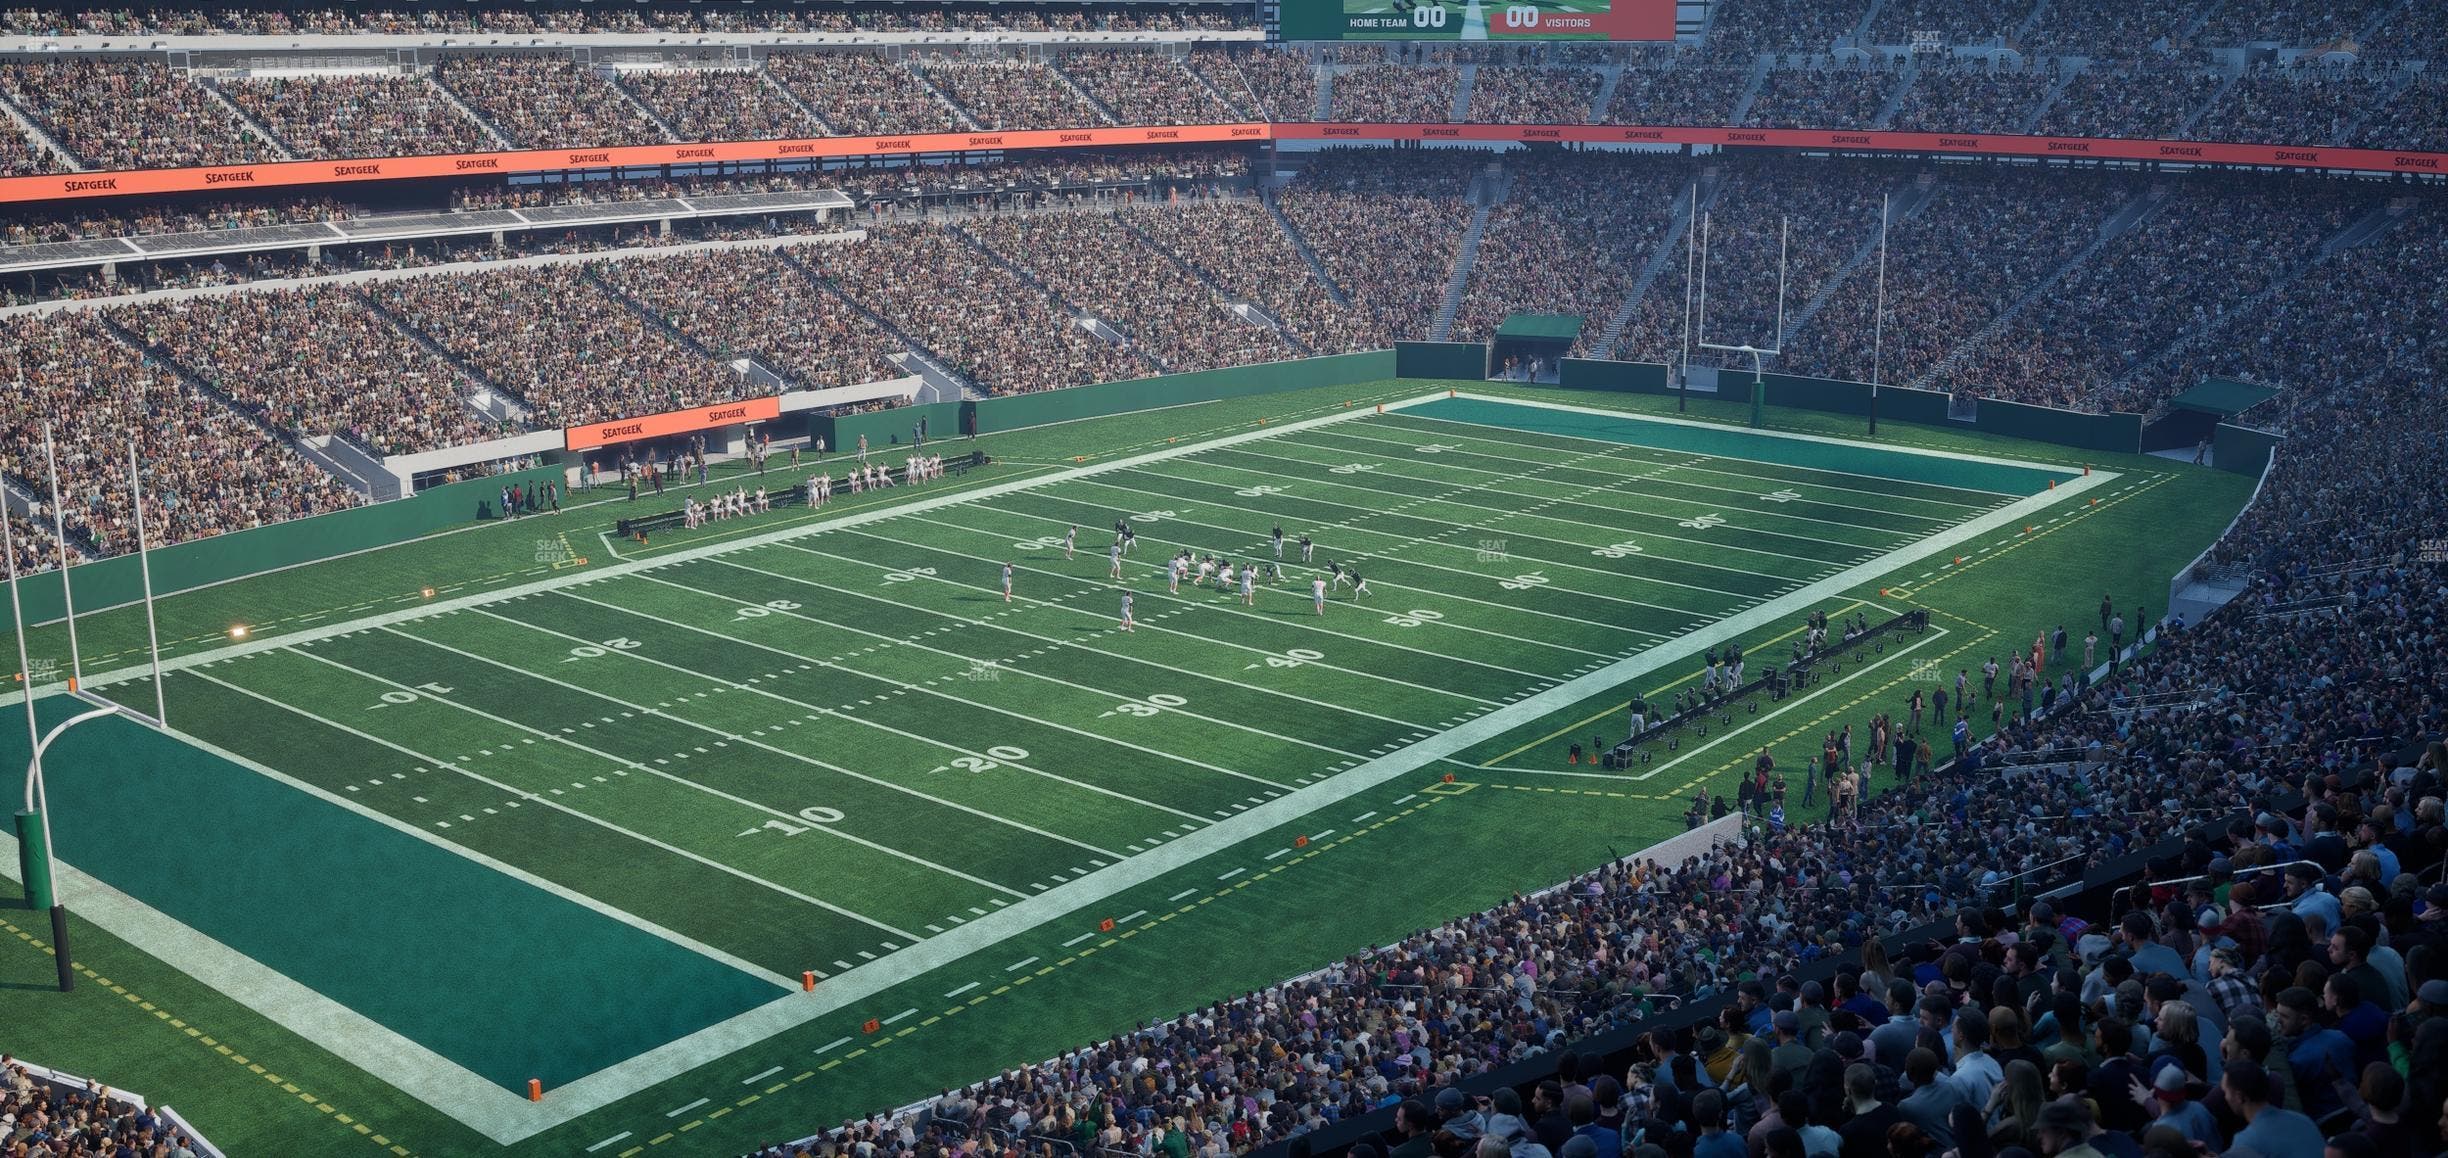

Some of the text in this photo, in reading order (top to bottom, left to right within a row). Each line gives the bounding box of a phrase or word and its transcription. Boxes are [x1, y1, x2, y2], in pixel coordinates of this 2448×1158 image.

[1349, 5, 1446, 28] HOME TEAM 00
[1506, 5, 1591, 28] 00 VISITORS
[1060, 132, 1092, 143] SEATGEEK
[1146, 130, 1178, 140] SEATGEEK
[1231, 128, 1261, 137] SEATGEEK
[1322, 127, 1360, 136] SEATGEEK
[1422, 128, 1460, 137] SEATGEEK
[1523, 129, 1561, 138] SEATGEEK
[1624, 130, 1663, 140] SEATGEEK
[1727, 132, 1766, 142] SEATGEEK
[875, 140, 911, 150] SEATGEEK
[968, 136, 1003, 146] SEATGEEK
[1831, 135, 1871, 145] SEATGEEK
[1939, 138, 1978, 148] SEATGEEK
[2047, 141, 2089, 152] SEATGEEK
[676, 148, 715, 159] SEATGEEK
[778, 144, 814, 154] SEATGEEK
[2159, 145, 2202, 157] SEATGEEK
[569, 152, 609, 164] SEATGEEK
[2274, 151, 2318, 162] SEATGEEK
[2394, 156, 2439, 169] SEATGEEK
[334, 164, 380, 177] SEATGEEK
[456, 158, 498, 170] SEATGEEK
[205, 170, 254, 184] SEATGEEK
[64, 178, 117, 193] SEATGEEK
[709, 406, 747, 422] SEATGEEK
[602, 422, 643, 440] SEATGEEK
[1677, 515, 1727, 530] 20
[1590, 543, 1643, 559] 30
[882, 566, 937, 583] 40
[1498, 573, 1550, 591] 40
[736, 599, 802, 618] 30
[1382, 609, 1444, 628] 50
[569, 636, 642, 658] 20
[1265, 648, 1325, 669] 40
[380, 681, 455, 704] 10
[1115, 693, 1188, 718] 30
[949, 745, 1030, 773] 20
[761, 806, 846, 837] 10
